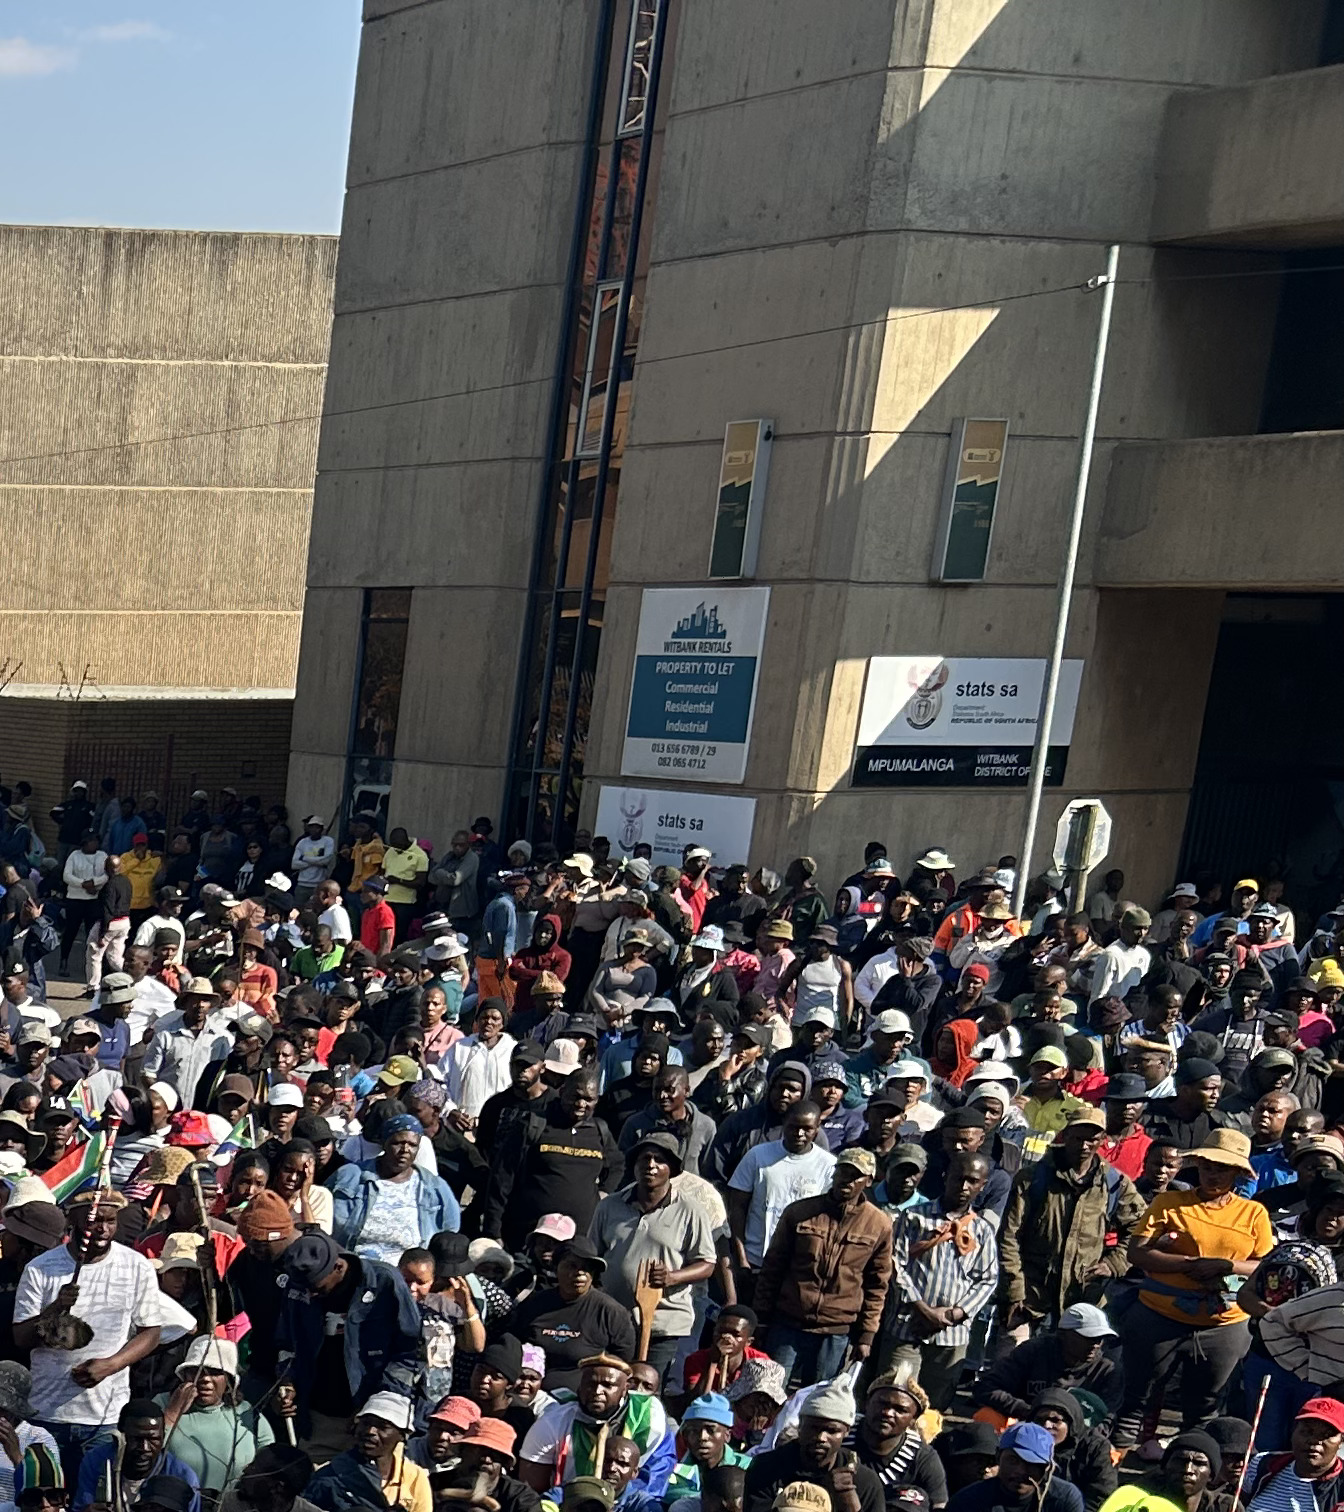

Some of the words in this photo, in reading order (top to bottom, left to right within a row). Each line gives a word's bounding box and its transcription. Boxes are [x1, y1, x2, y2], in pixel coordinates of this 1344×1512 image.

[663, 641, 696, 653] WITBANK
[698, 641, 732, 654] RENTALS
[655, 661, 702, 675] PROPERTY
[703, 662, 715, 675] TO
[717, 662, 734, 675] LET
[665, 681, 719, 695] Commercial
[955, 681, 995, 697] stats
[999, 683, 1018, 697] sa
[664, 700, 714, 714] Residential
[665, 720, 709, 733] Industrial
[651, 743, 665, 753] 013
[706, 746, 717, 756] 29
[657, 756, 671, 767] 082
[687, 758, 706, 769] 4712
[977, 753, 1020, 764] WITBANK
[867, 758, 955, 773] MPUMALANGA
[974, 766, 1016, 777] DISTRICT
[657, 812, 686, 830] stats
[689, 817, 704, 831] sa
